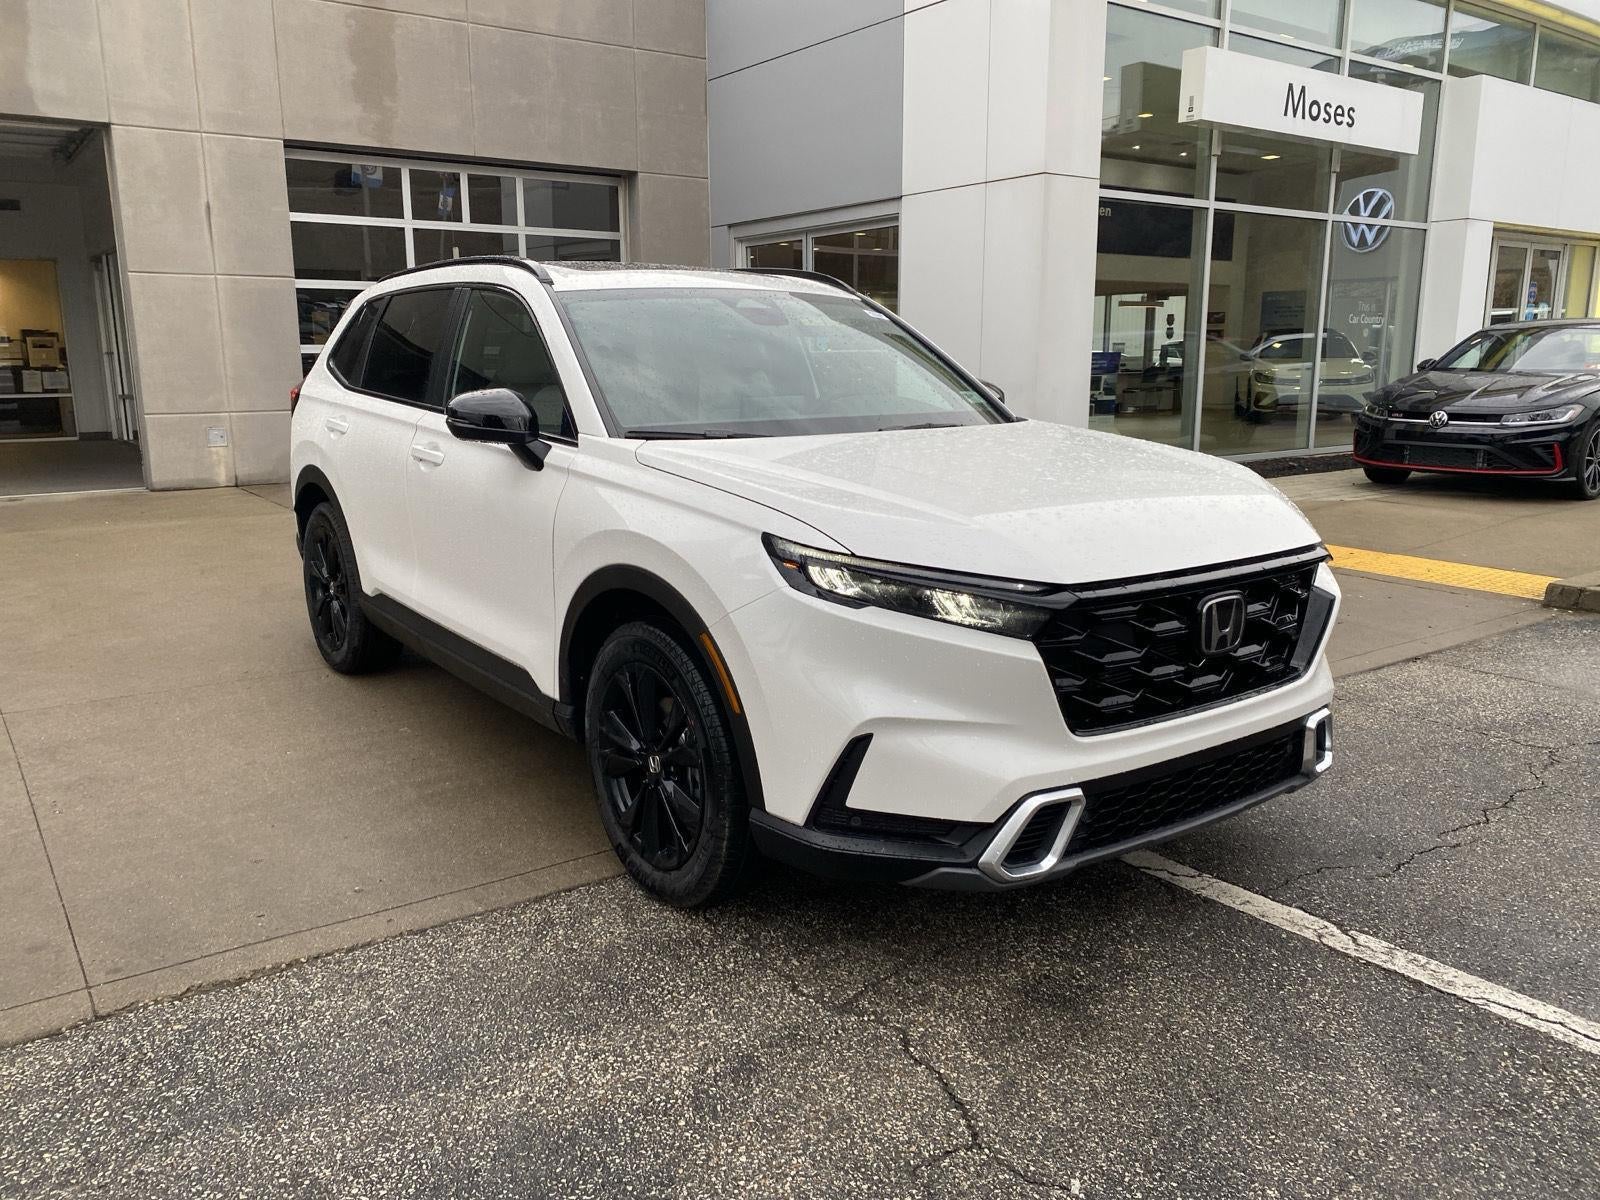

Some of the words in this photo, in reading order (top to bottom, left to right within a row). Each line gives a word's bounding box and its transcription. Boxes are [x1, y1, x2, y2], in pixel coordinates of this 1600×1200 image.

[1284, 82, 1356, 128] Moses
[1348, 313, 1359, 323] Car
[1360, 313, 1385, 328] Country
